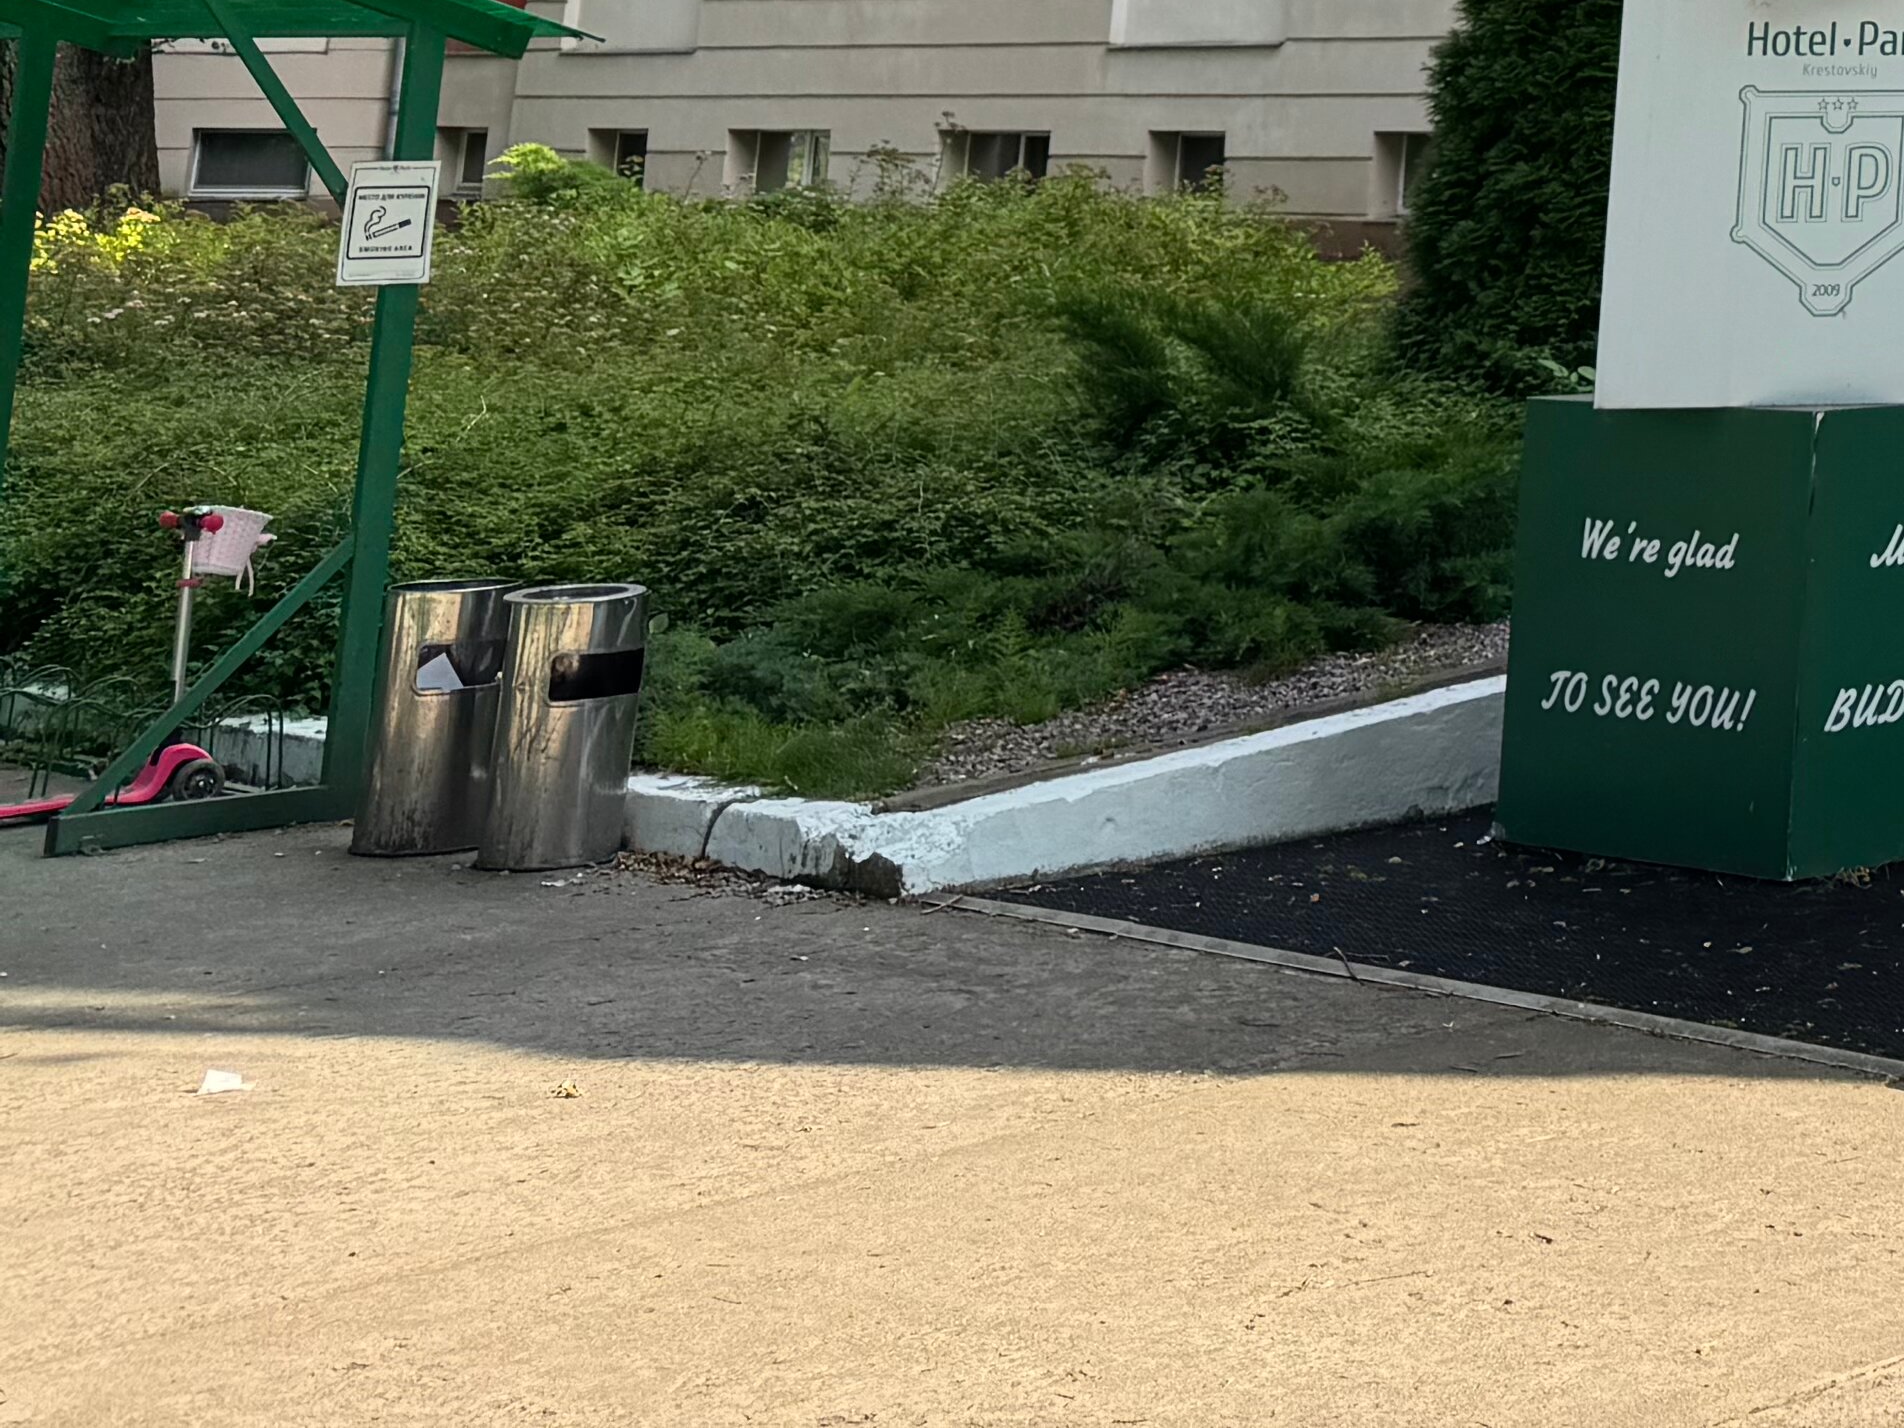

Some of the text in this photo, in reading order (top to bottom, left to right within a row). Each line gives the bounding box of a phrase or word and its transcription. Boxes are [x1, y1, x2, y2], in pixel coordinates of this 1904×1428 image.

[1747, 21, 1837, 56] Hotel
[1802, 63, 1878, 80] Krestovskiy
[1811, 283, 1841, 297] 2009
[1581, 517, 1740, 578] We're glad
[1540, 670, 1757, 732] TO SEE YOU!
